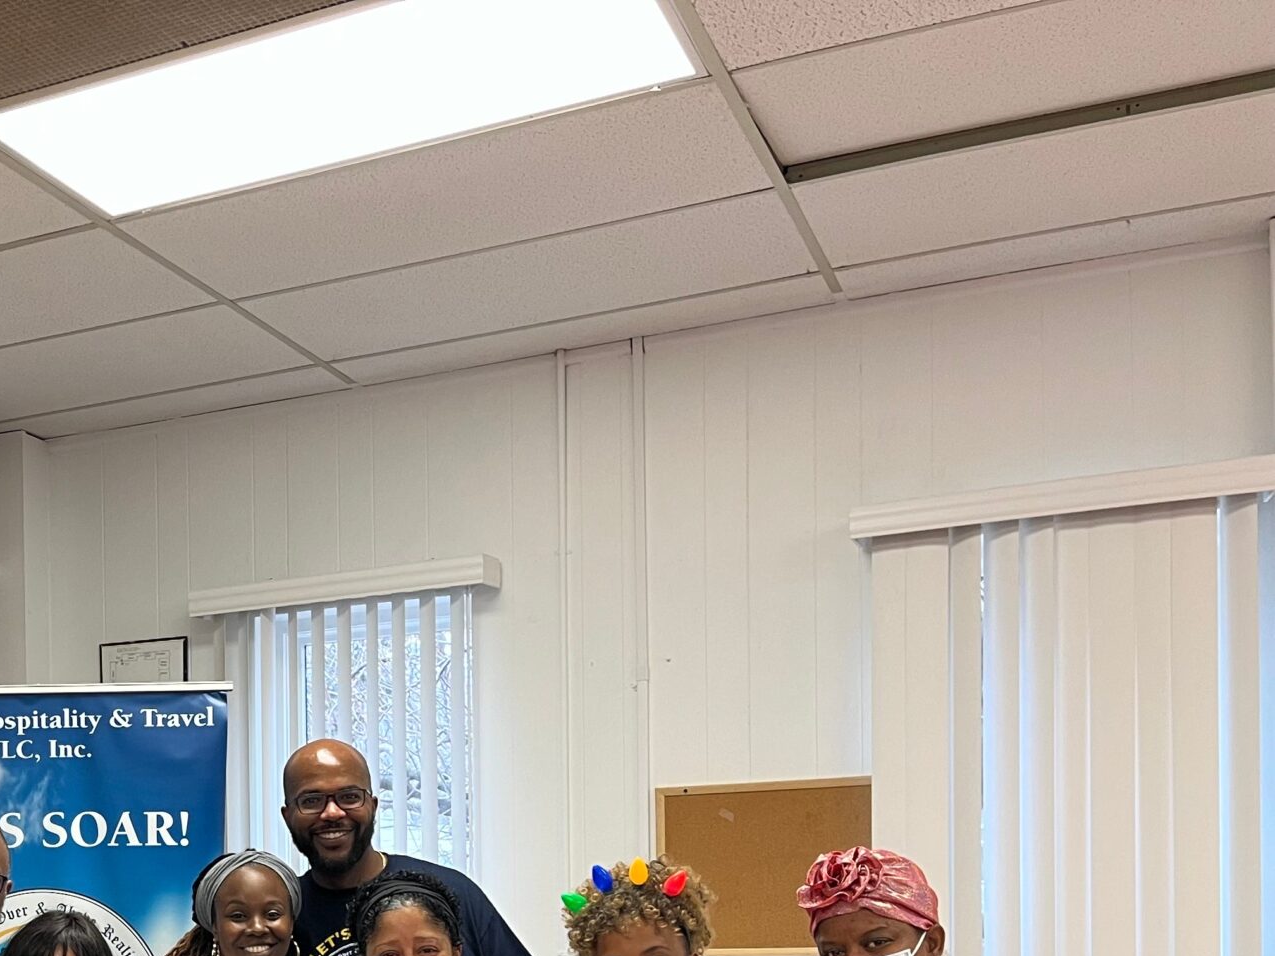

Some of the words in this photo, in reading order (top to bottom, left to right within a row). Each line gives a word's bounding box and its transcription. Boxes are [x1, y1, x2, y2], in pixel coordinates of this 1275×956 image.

[109, 708, 133, 728] &
[140, 707, 215, 728] Travel
[48, 740, 93, 758] Inc.
[42, 811, 190, 848] SOAR!
